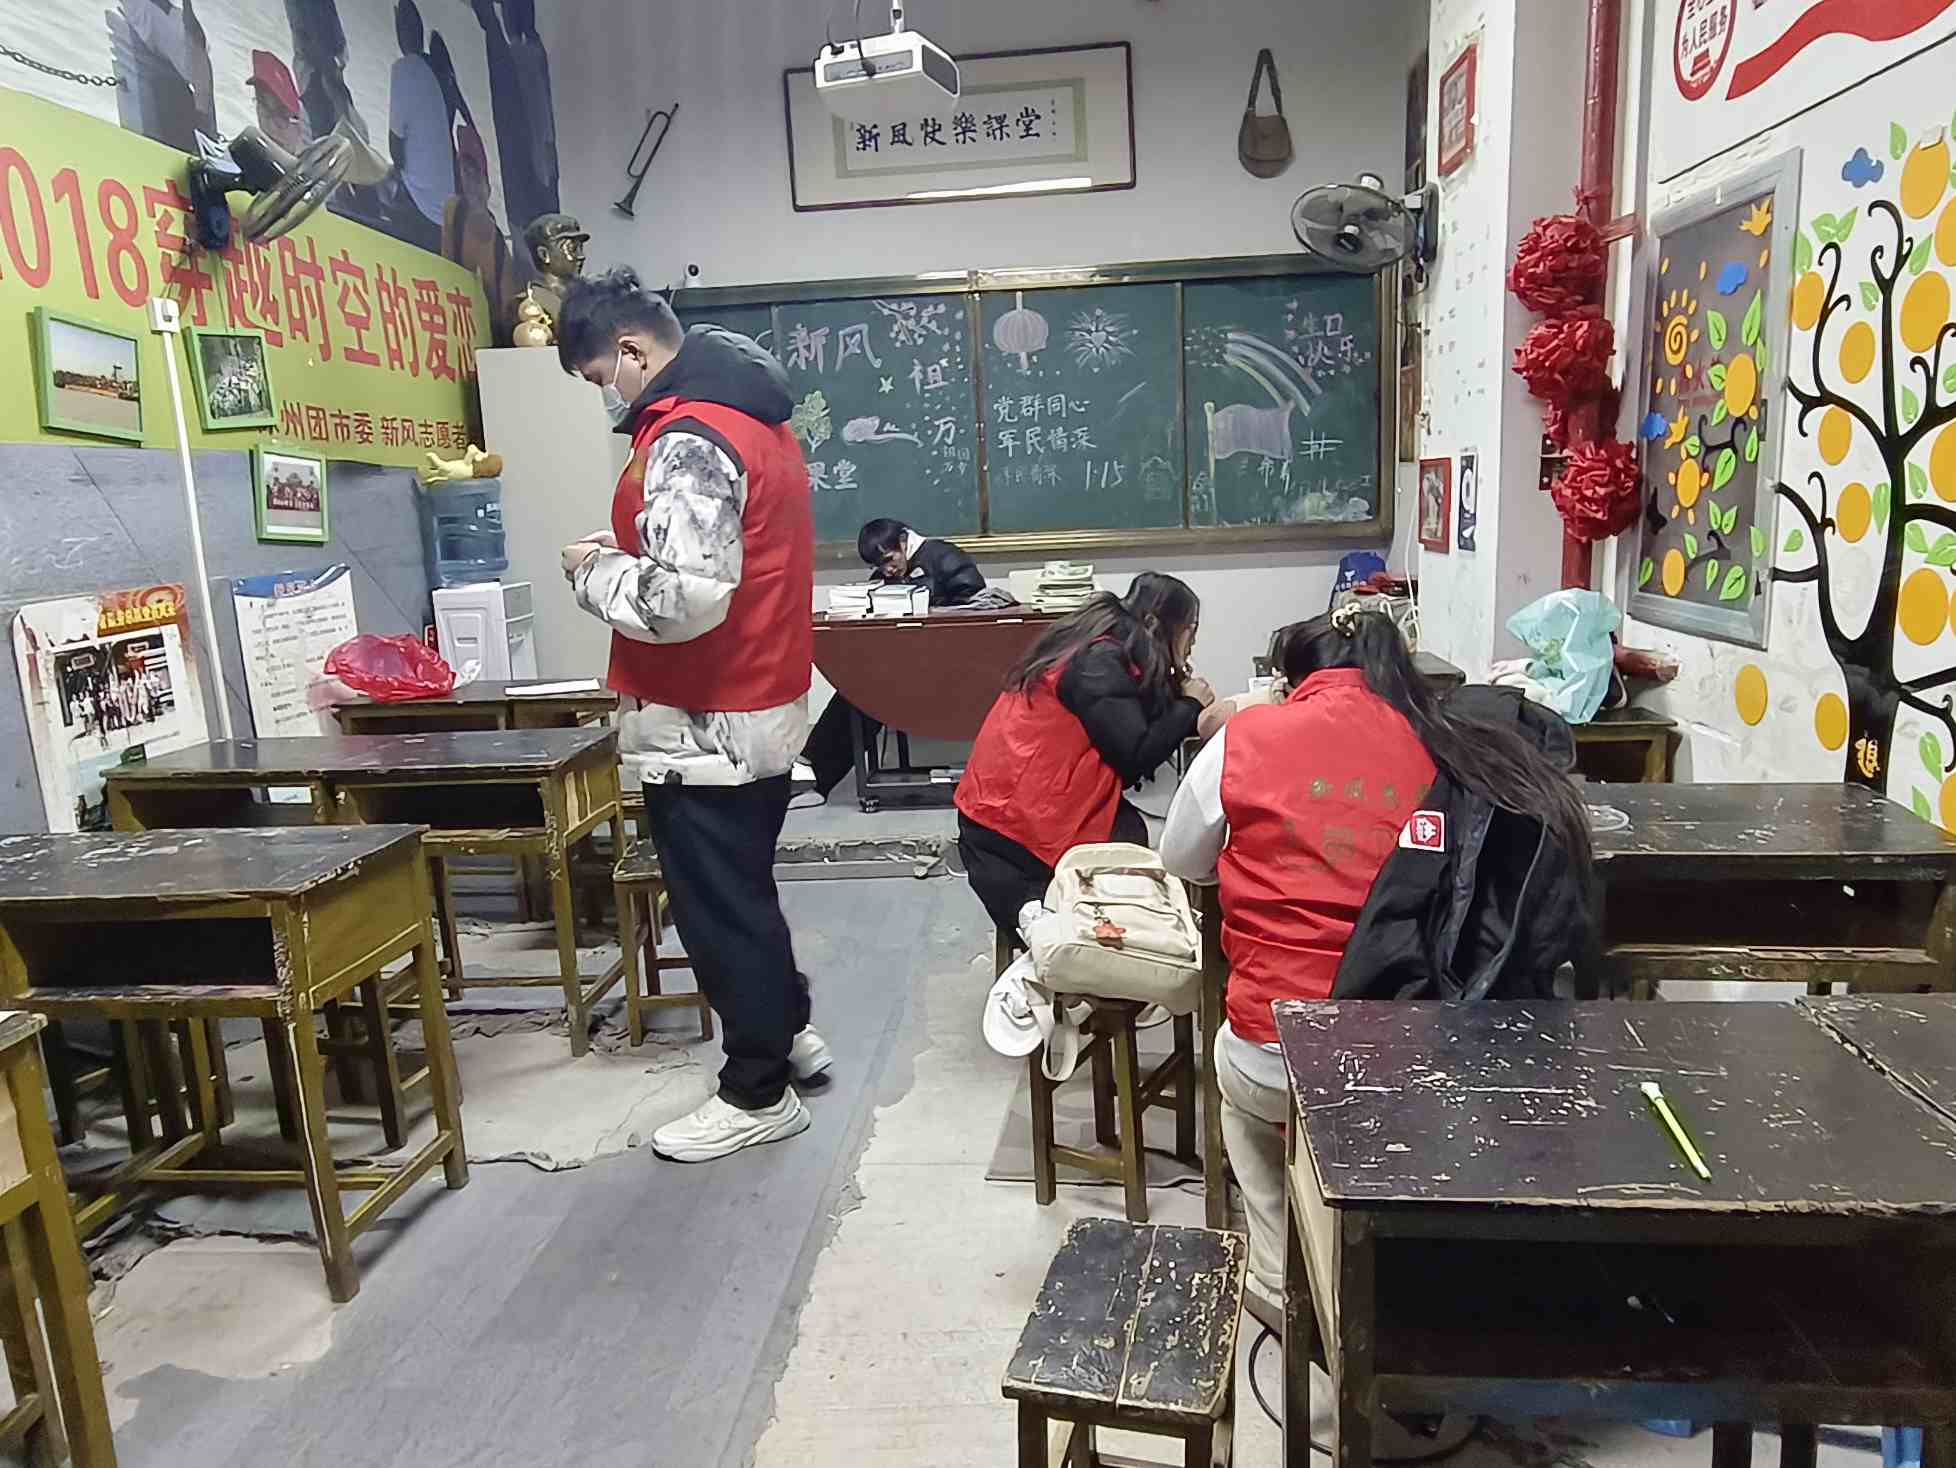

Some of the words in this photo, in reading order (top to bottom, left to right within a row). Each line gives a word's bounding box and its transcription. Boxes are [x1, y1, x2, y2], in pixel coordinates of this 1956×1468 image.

[0, 146, 477, 384] 018穿越时空的爱恋
[788, 323, 882, 374] 新风
[256, 400, 374, 445] 州团市委
[380, 416, 468, 450] 新风志愿者
[993, 393, 1091, 423] 党群同心
[997, 426, 1097, 457] 军民情深
